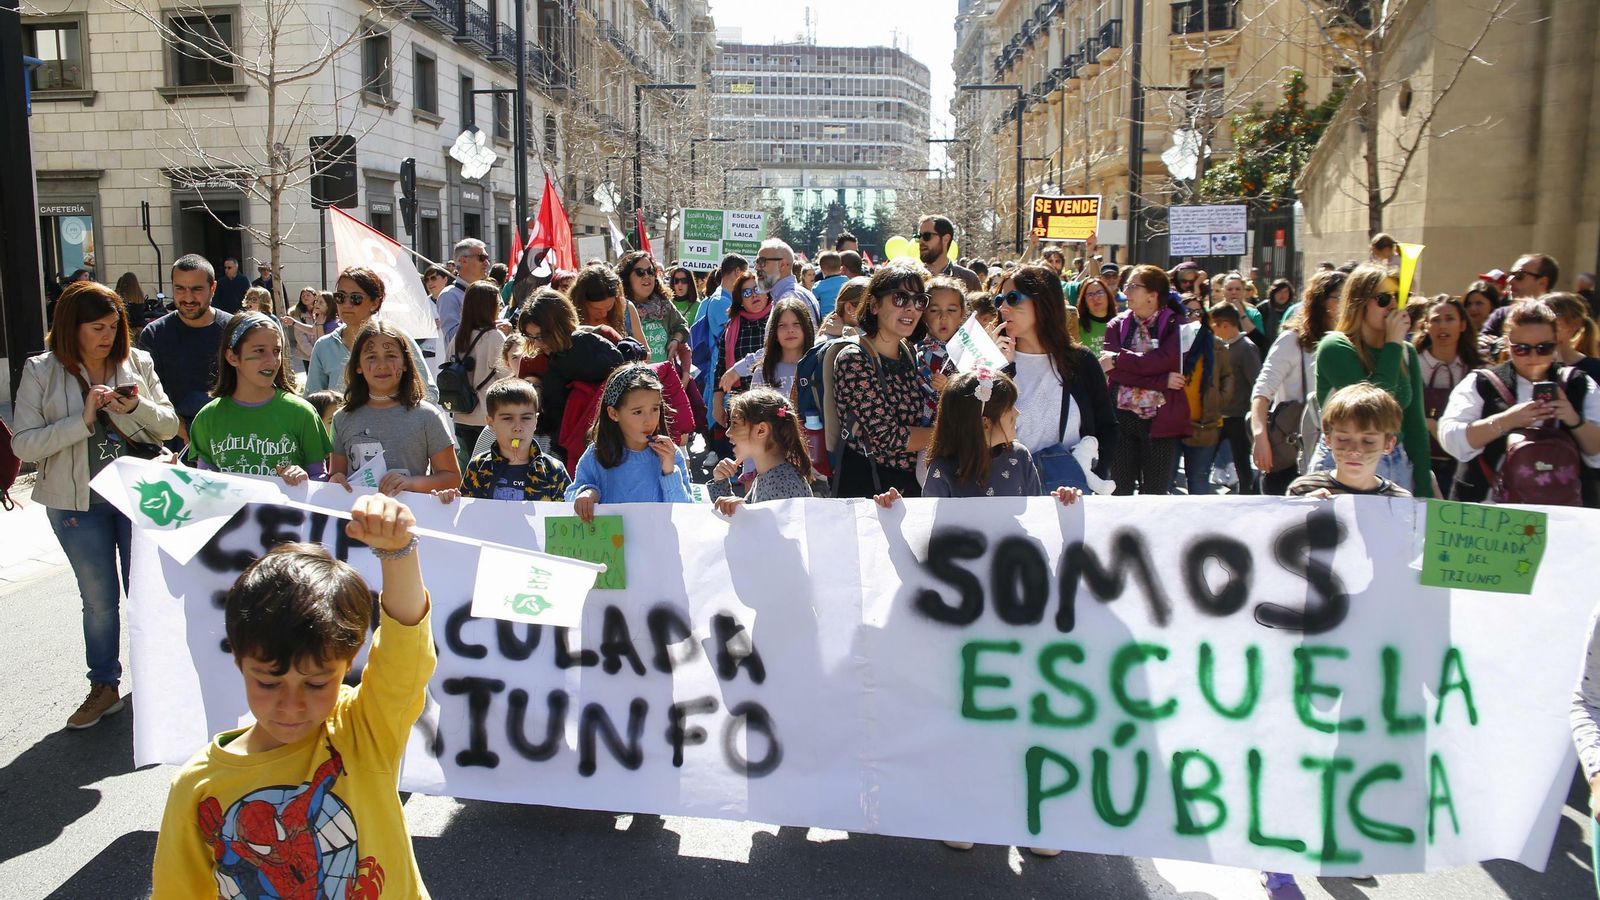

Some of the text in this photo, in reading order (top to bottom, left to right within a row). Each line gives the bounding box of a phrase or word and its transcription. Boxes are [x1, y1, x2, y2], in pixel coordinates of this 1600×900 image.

[40, 205, 85, 213] CAFETERÍA
[1035, 198, 1098, 214] SE VENDE
[732, 212, 762, 220] ESCUELA
[732, 222, 760, 230] PUBLICA
[682, 261, 719, 270] CALIDAD
[209, 437, 297, 456] ESCUELA PÚBLICA
[1438, 503, 1513, 536] C.E.I.P.
[1436, 530, 1528, 555] INMACULADA
[1466, 553, 1489, 565] DEL
[914, 512, 1349, 634] SOMOS
[1439, 568, 1502, 586] TRIUNFO
[960, 640, 1479, 734] ESCUELA
[1025, 722, 1462, 863] PÚBLICA
